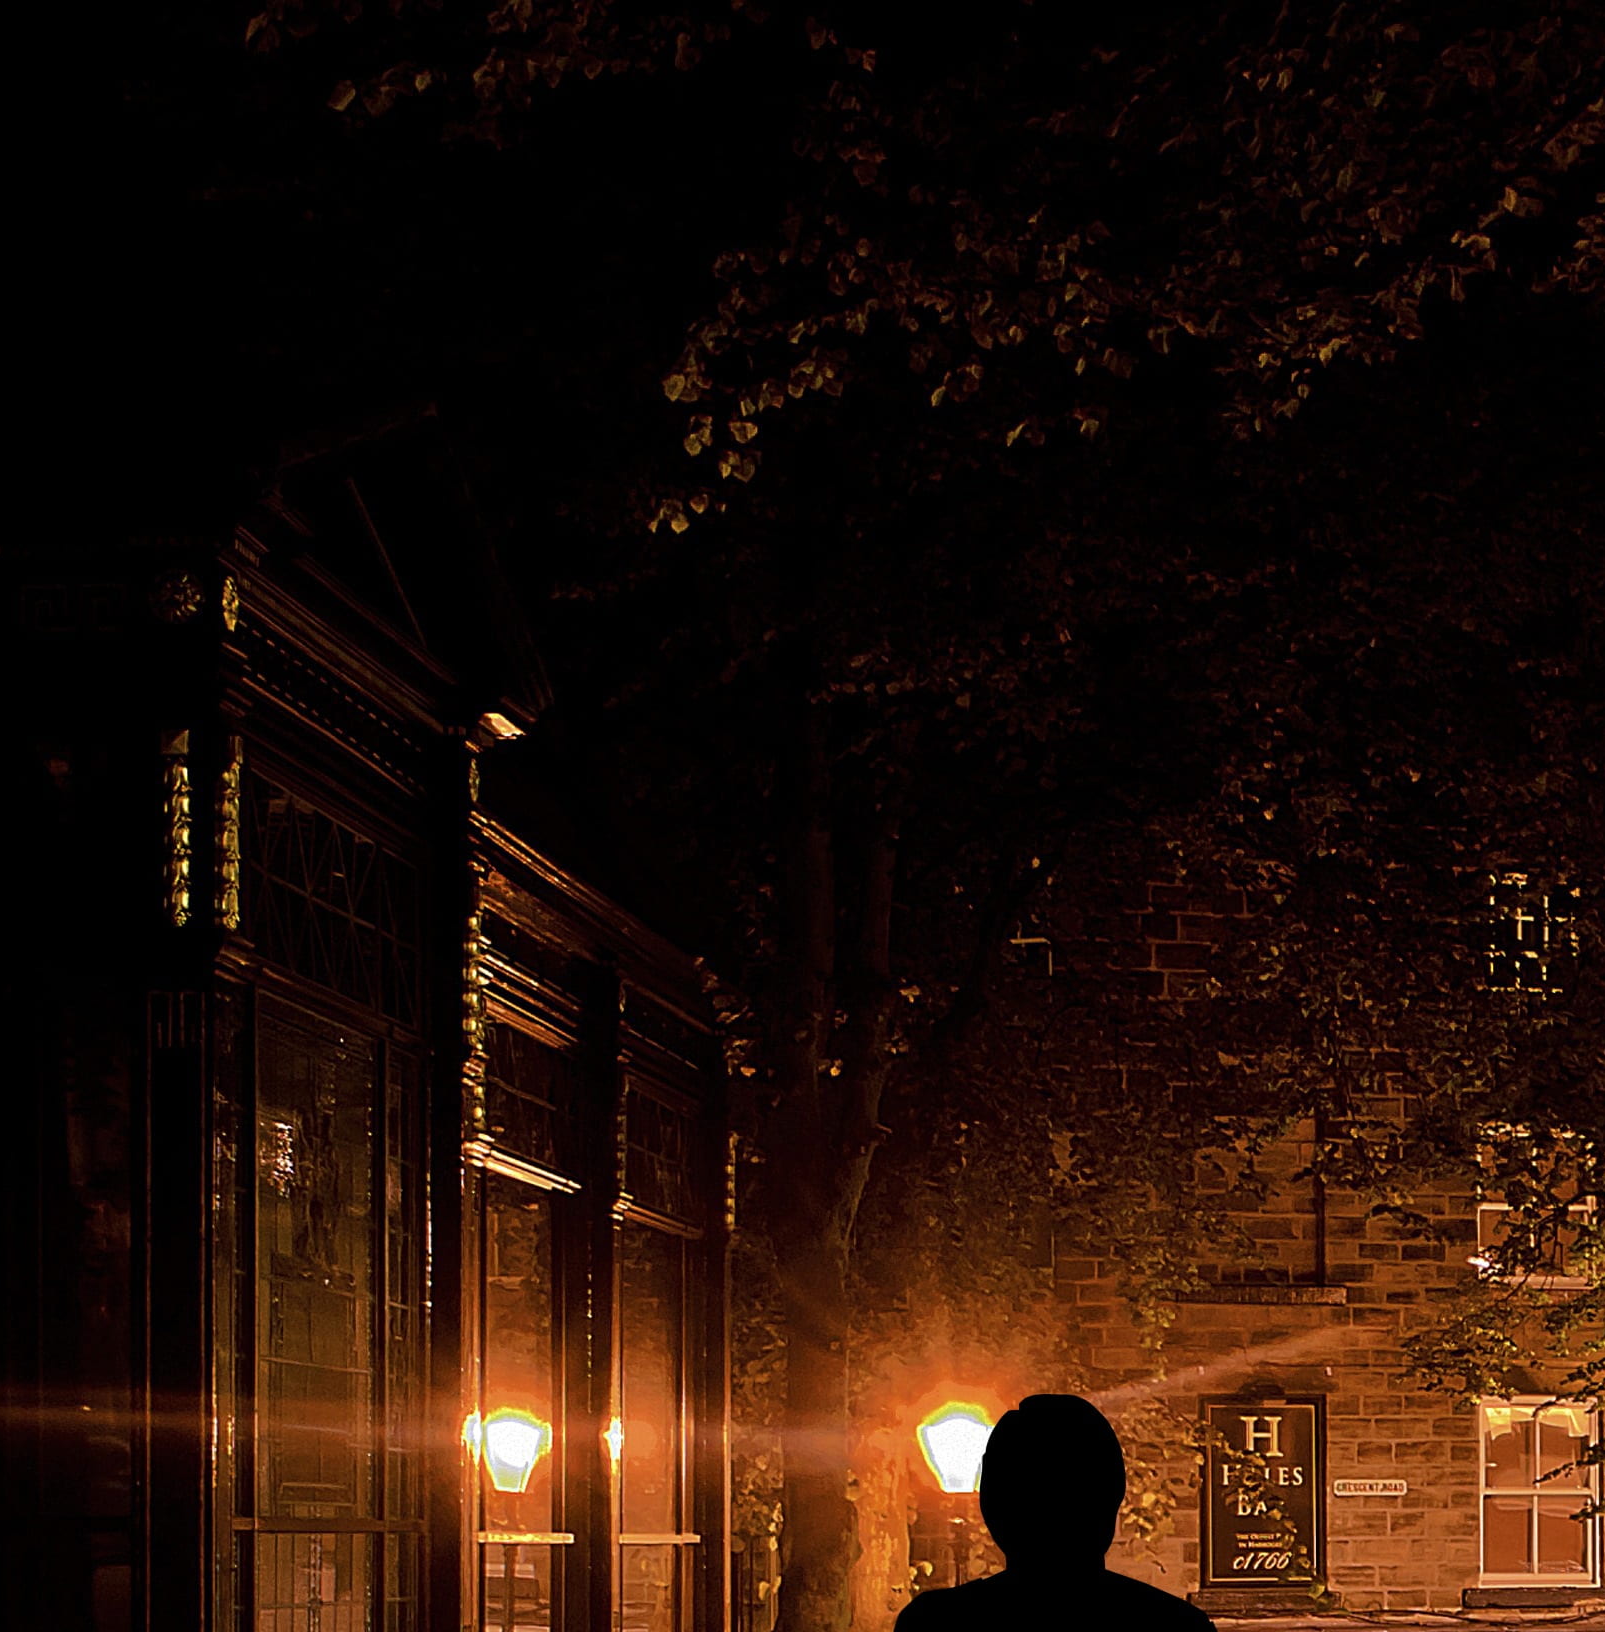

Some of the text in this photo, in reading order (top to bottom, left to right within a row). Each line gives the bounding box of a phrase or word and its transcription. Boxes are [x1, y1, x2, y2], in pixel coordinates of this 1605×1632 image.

[1239, 1416, 1284, 1457] H
[1222, 1464, 1303, 1486] HES
[1337, 1483, 1404, 1493] CRESCENT ROAD
[1237, 1493, 1284, 1516] BA
